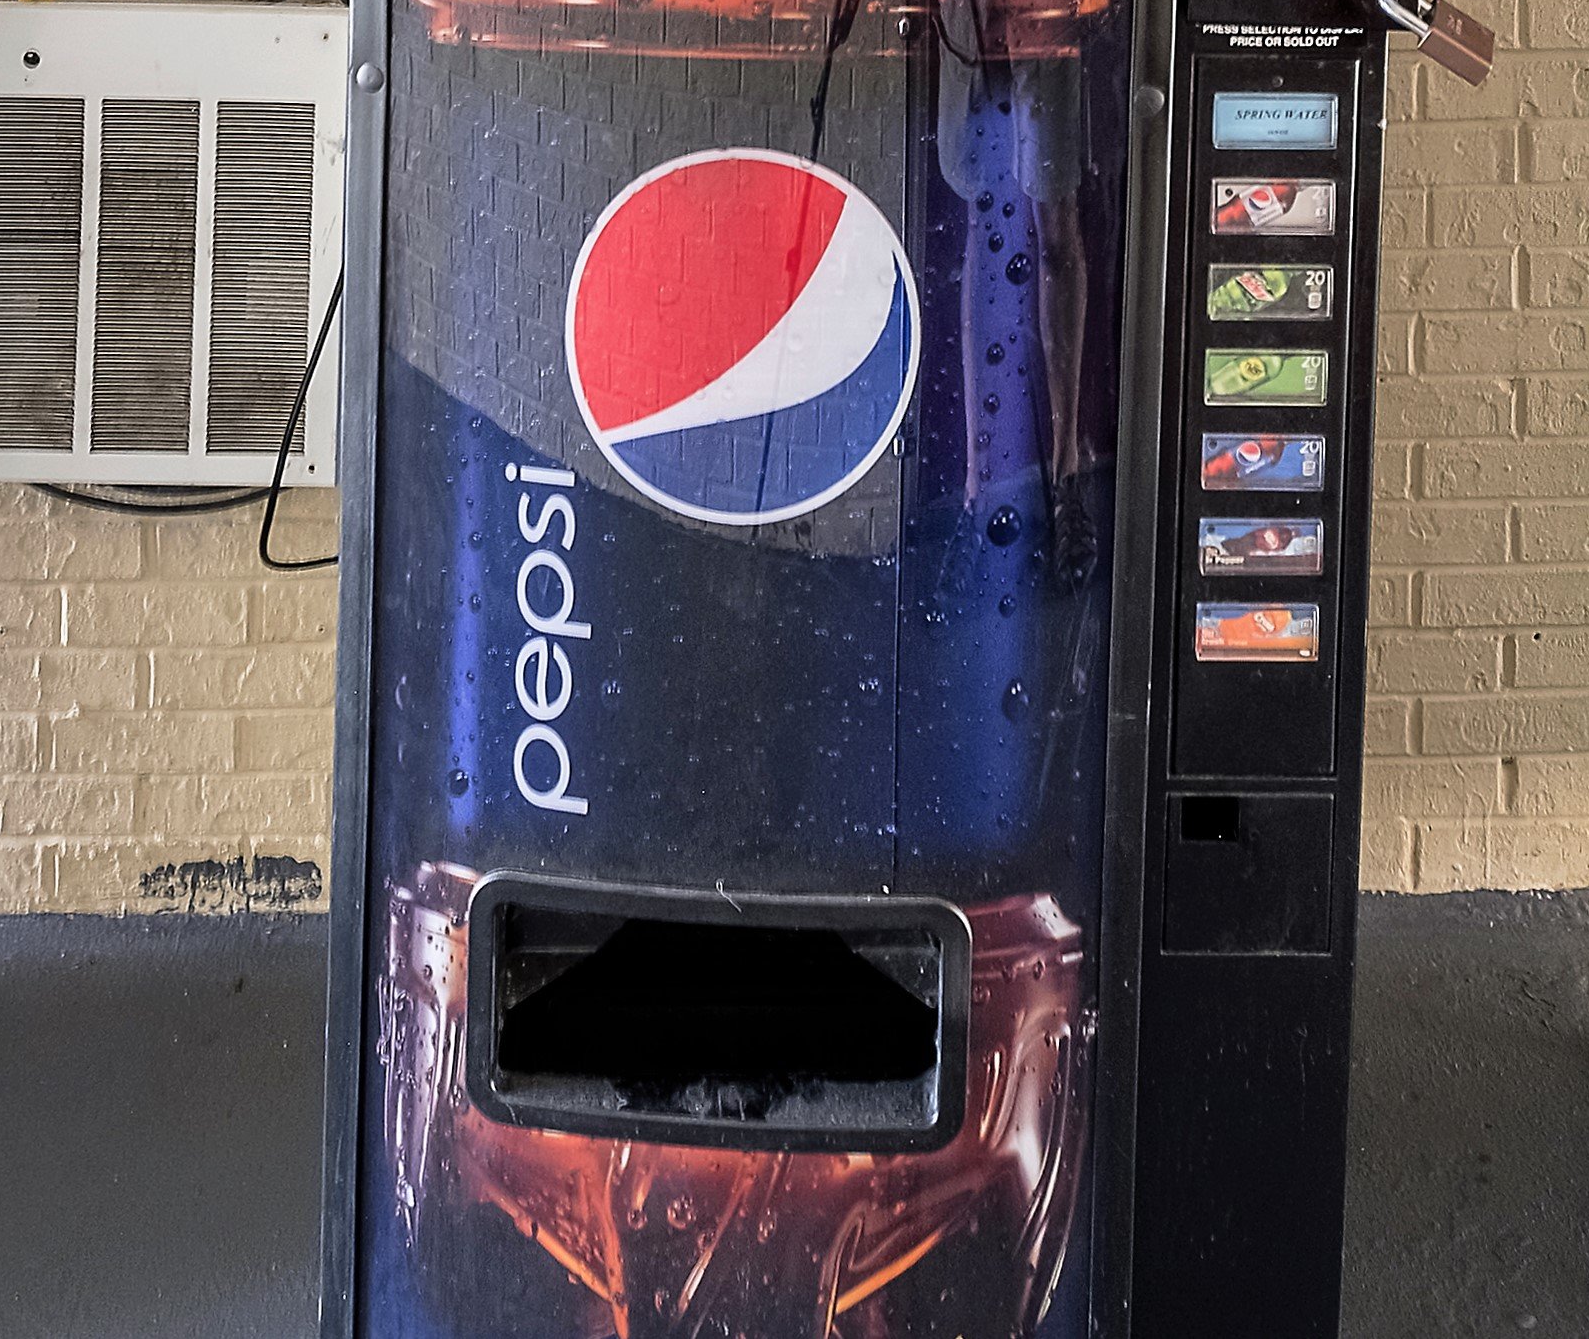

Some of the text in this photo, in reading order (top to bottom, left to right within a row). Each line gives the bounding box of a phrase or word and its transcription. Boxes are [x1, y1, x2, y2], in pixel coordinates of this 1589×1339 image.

[1202, 24, 1239, 35] PRESS
[1230, 35, 1340, 47] PRICE OR SOLD OUT
[1236, 109, 1327, 120] SPRING WATER
[1305, 271, 1325, 286] 20
[1301, 356, 1321, 369] 20
[1299, 440, 1319, 454] 20
[504, 460, 592, 815] pepsi
